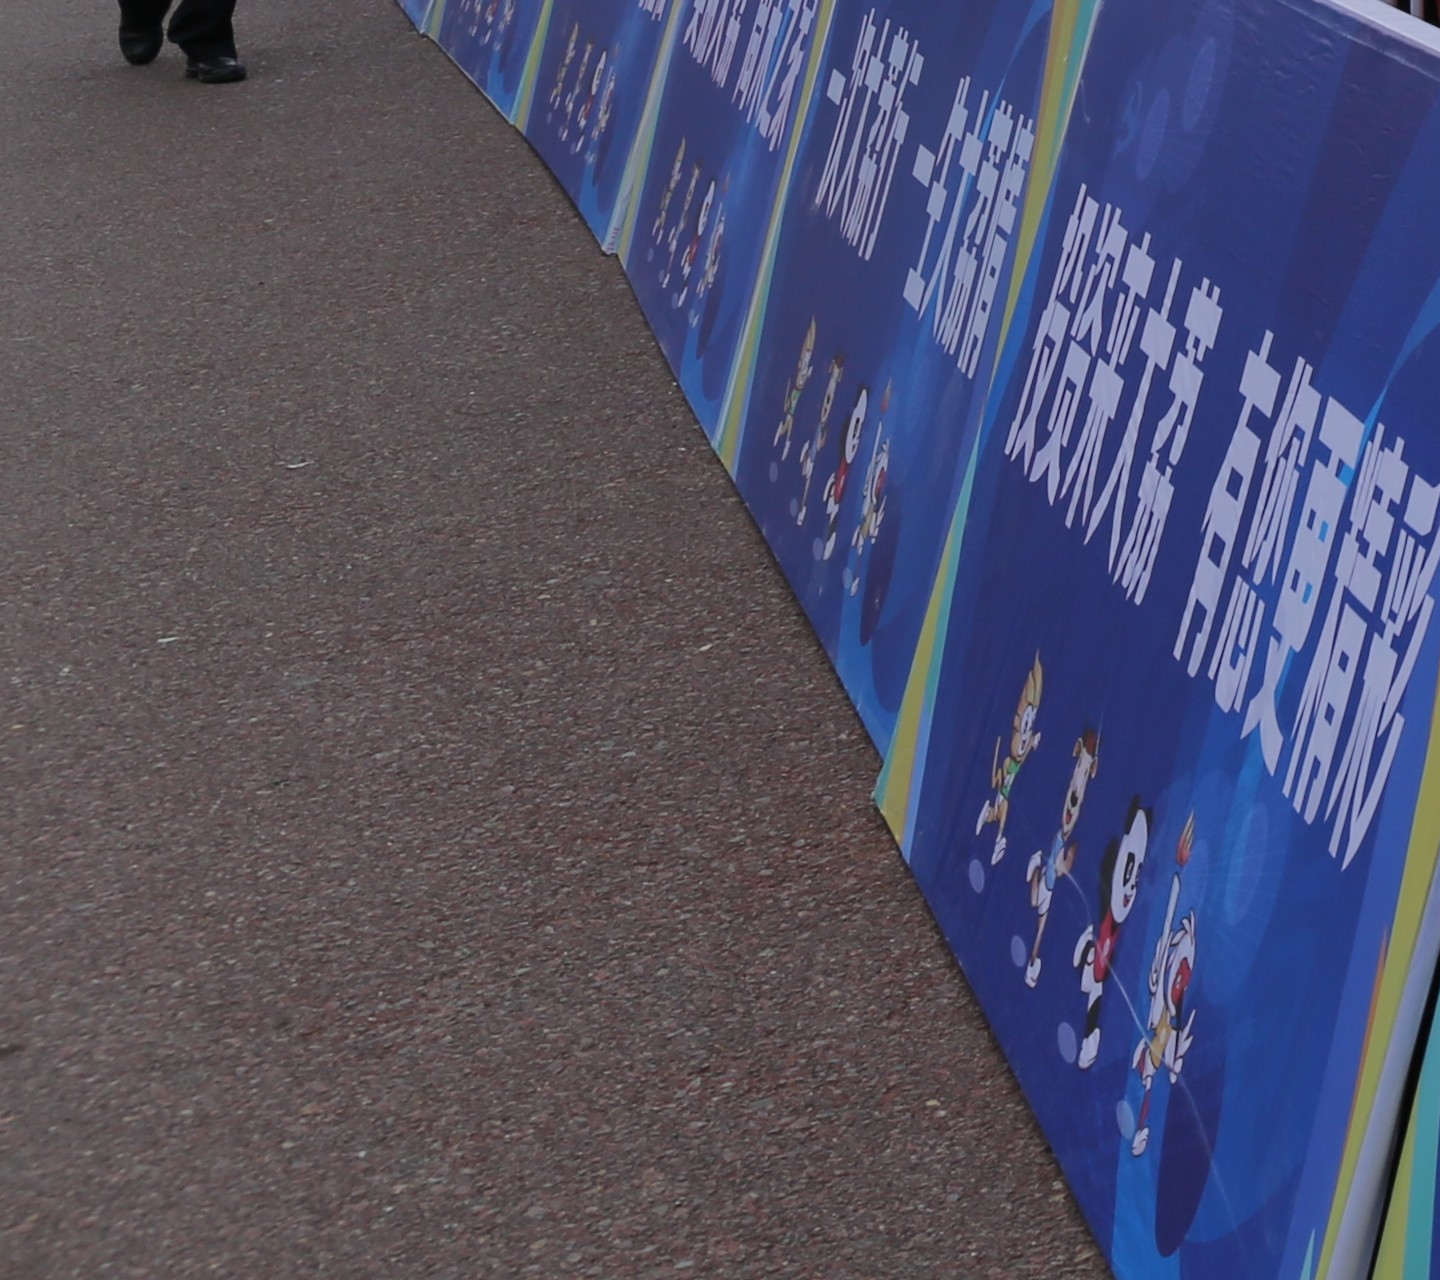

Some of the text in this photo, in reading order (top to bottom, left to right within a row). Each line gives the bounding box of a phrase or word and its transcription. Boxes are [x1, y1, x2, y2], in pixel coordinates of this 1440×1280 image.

[814, 7, 1036, 380] 一次大荔行 一生大荔情
[1004, 183, 1223, 607] 投资来大荔
